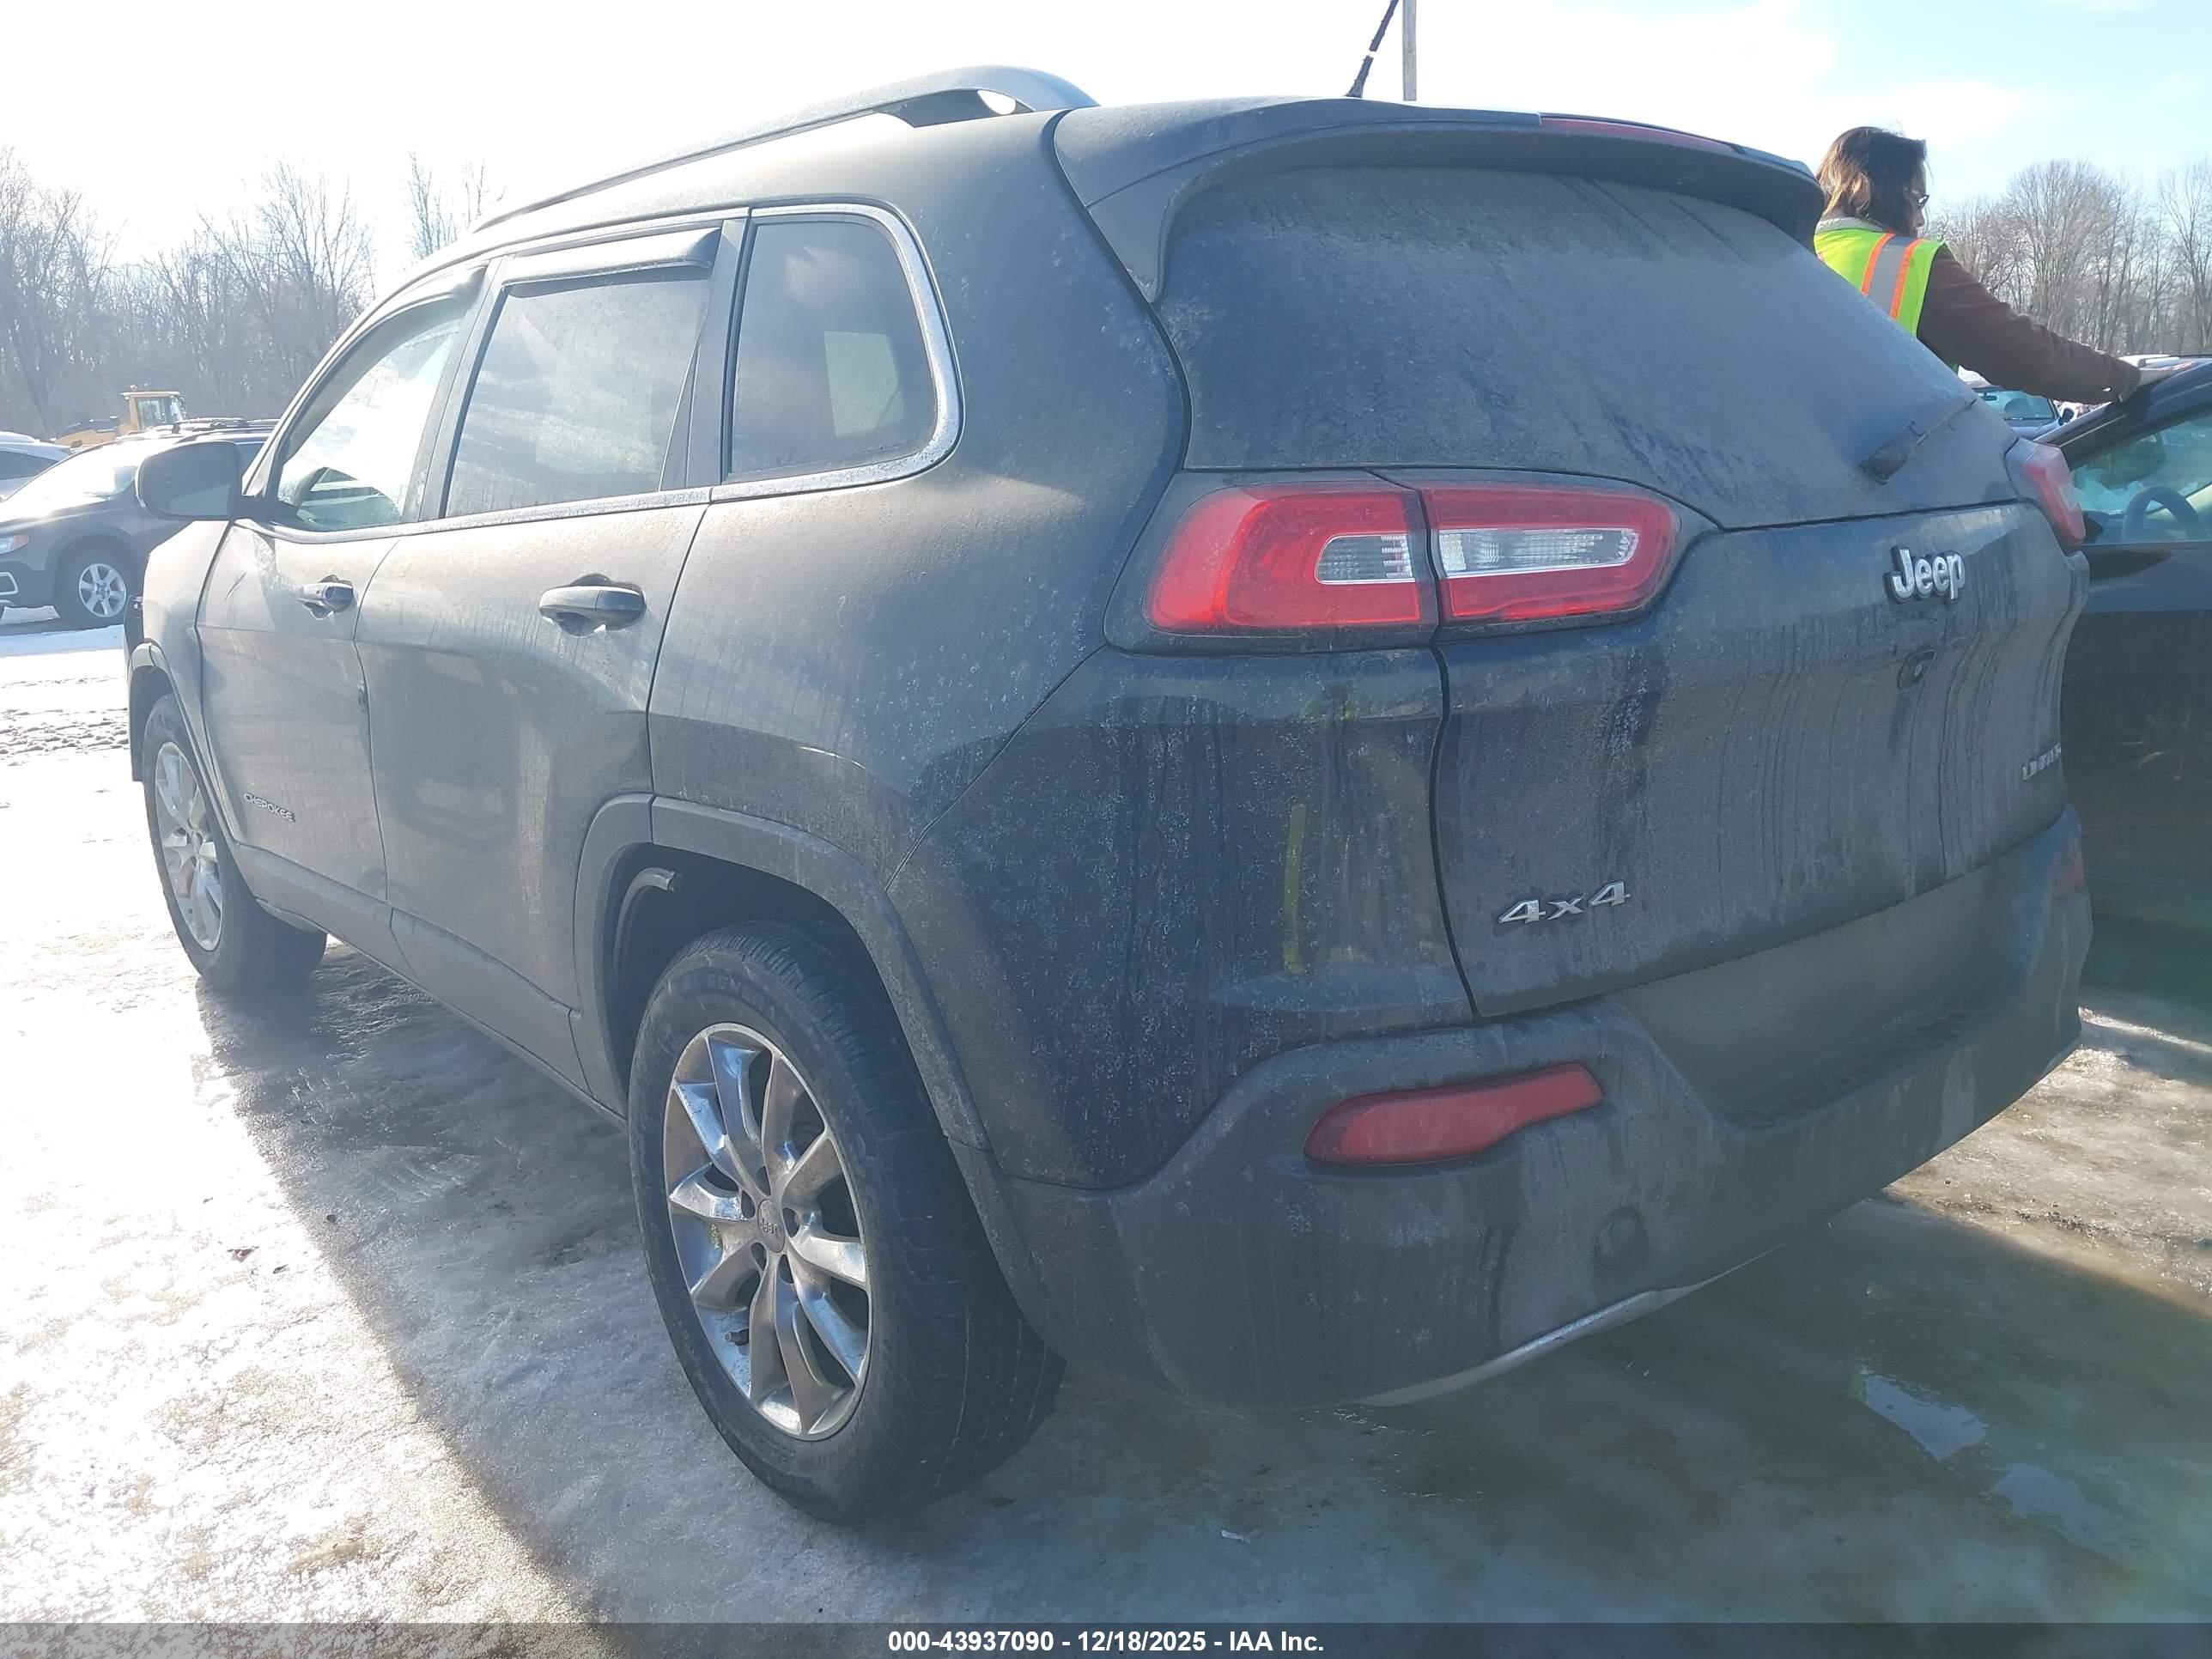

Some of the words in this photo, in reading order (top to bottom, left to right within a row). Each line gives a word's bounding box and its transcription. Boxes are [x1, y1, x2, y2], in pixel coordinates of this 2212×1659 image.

[1887, 548, 1966, 601] Jeep
[244, 793, 295, 824] CHEROKEE
[1498, 879, 1631, 924] 4x4
